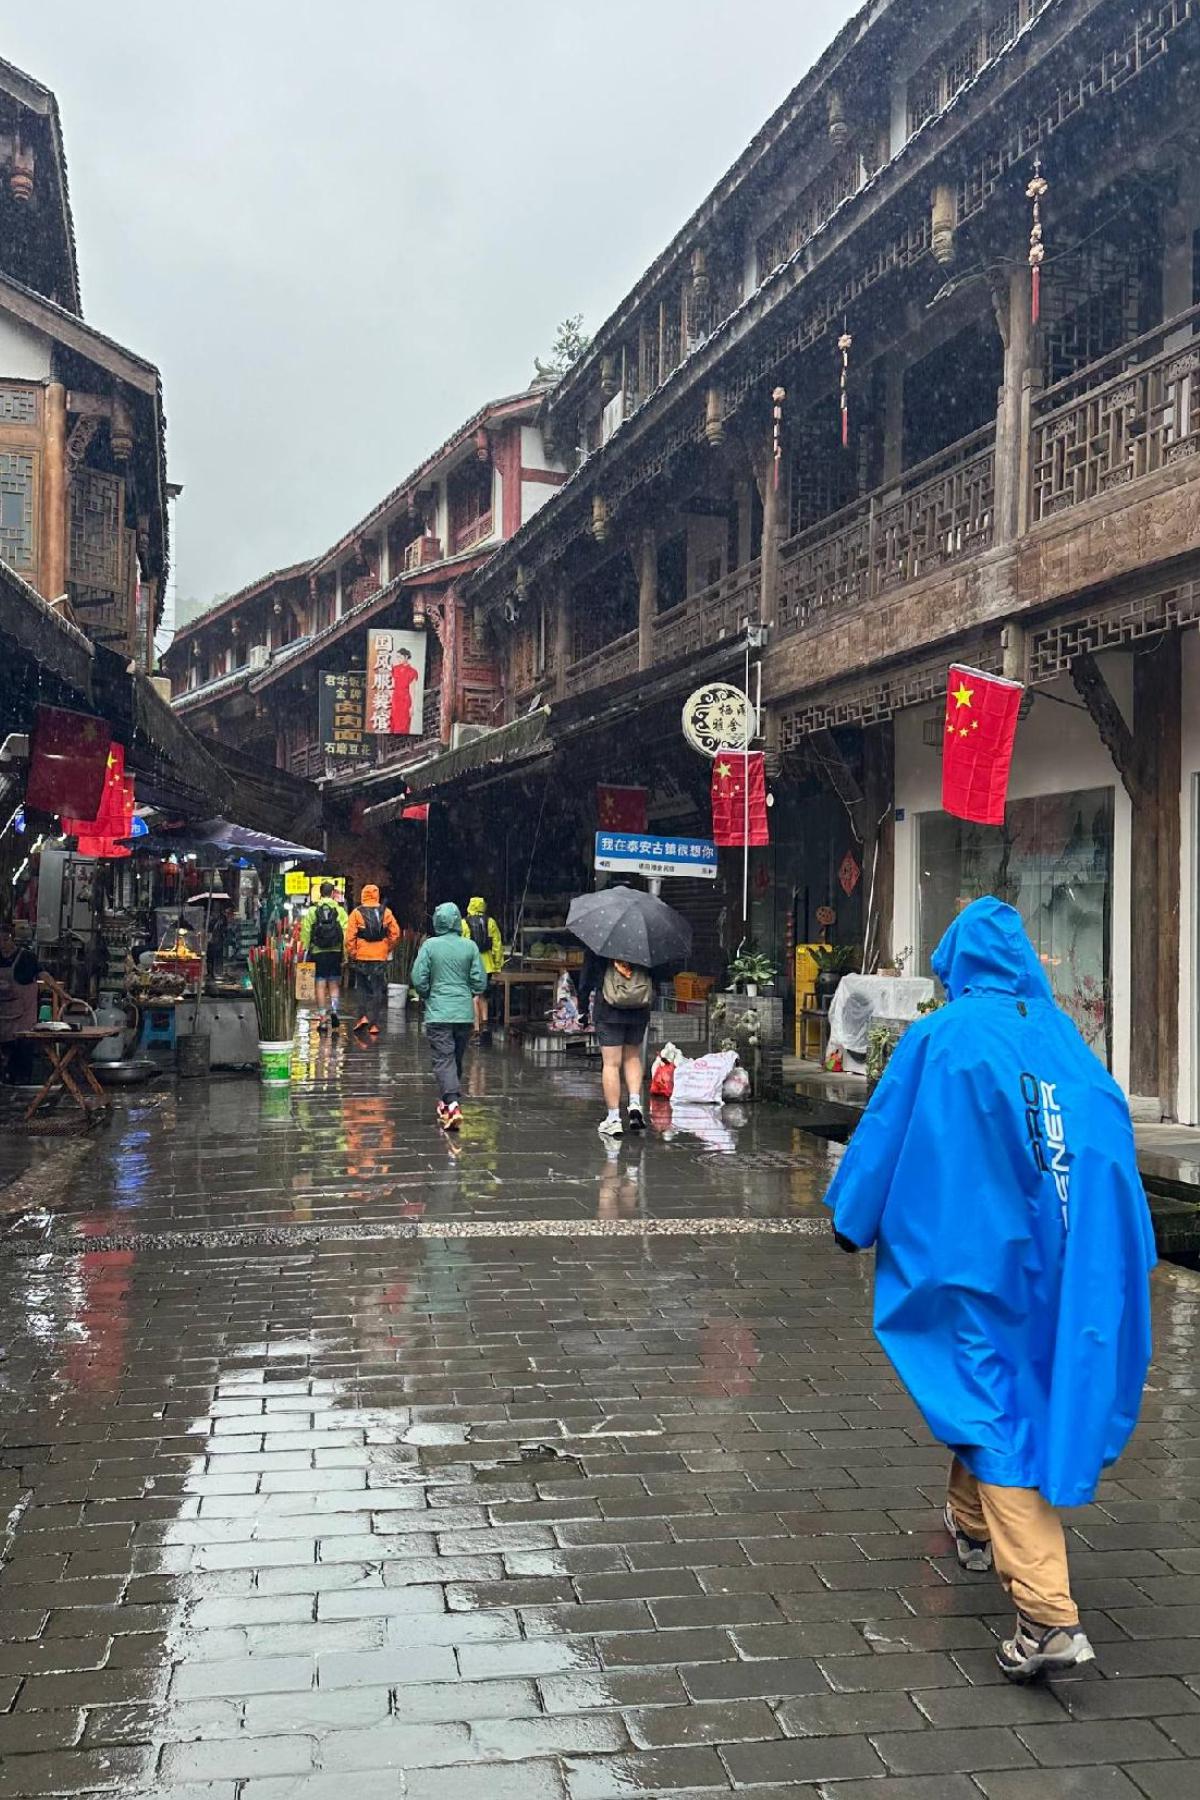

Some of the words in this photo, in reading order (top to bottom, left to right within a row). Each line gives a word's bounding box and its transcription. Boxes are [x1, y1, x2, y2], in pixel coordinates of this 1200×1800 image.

[370, 634, 394, 733] 国风服装馆
